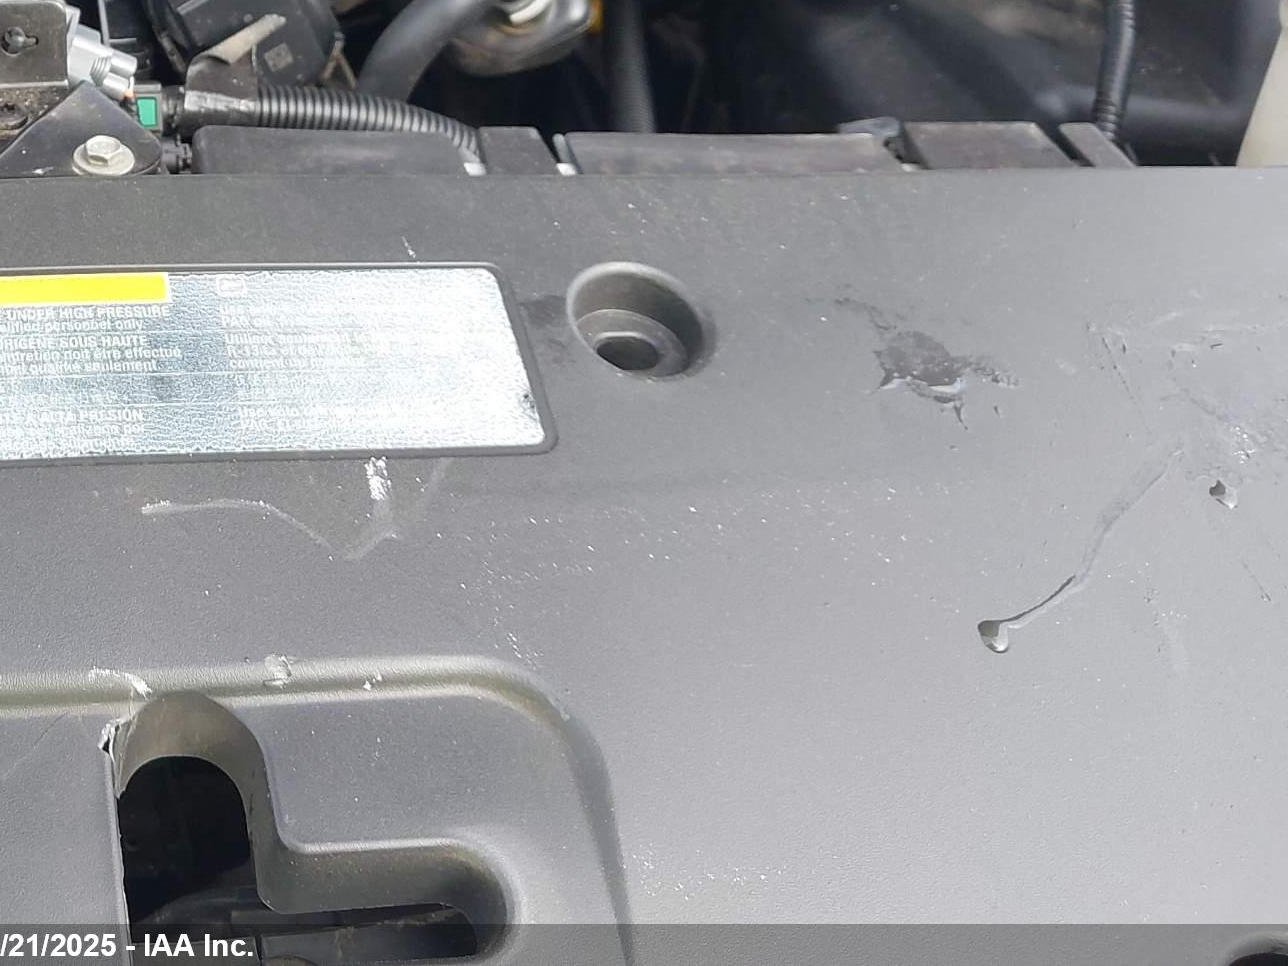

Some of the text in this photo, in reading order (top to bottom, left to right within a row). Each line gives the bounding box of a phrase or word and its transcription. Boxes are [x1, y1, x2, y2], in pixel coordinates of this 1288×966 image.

[97, 305, 170, 318] PRESSURE
[60, 335, 97, 348] SOUS
[102, 333, 149, 347] HAUTE
